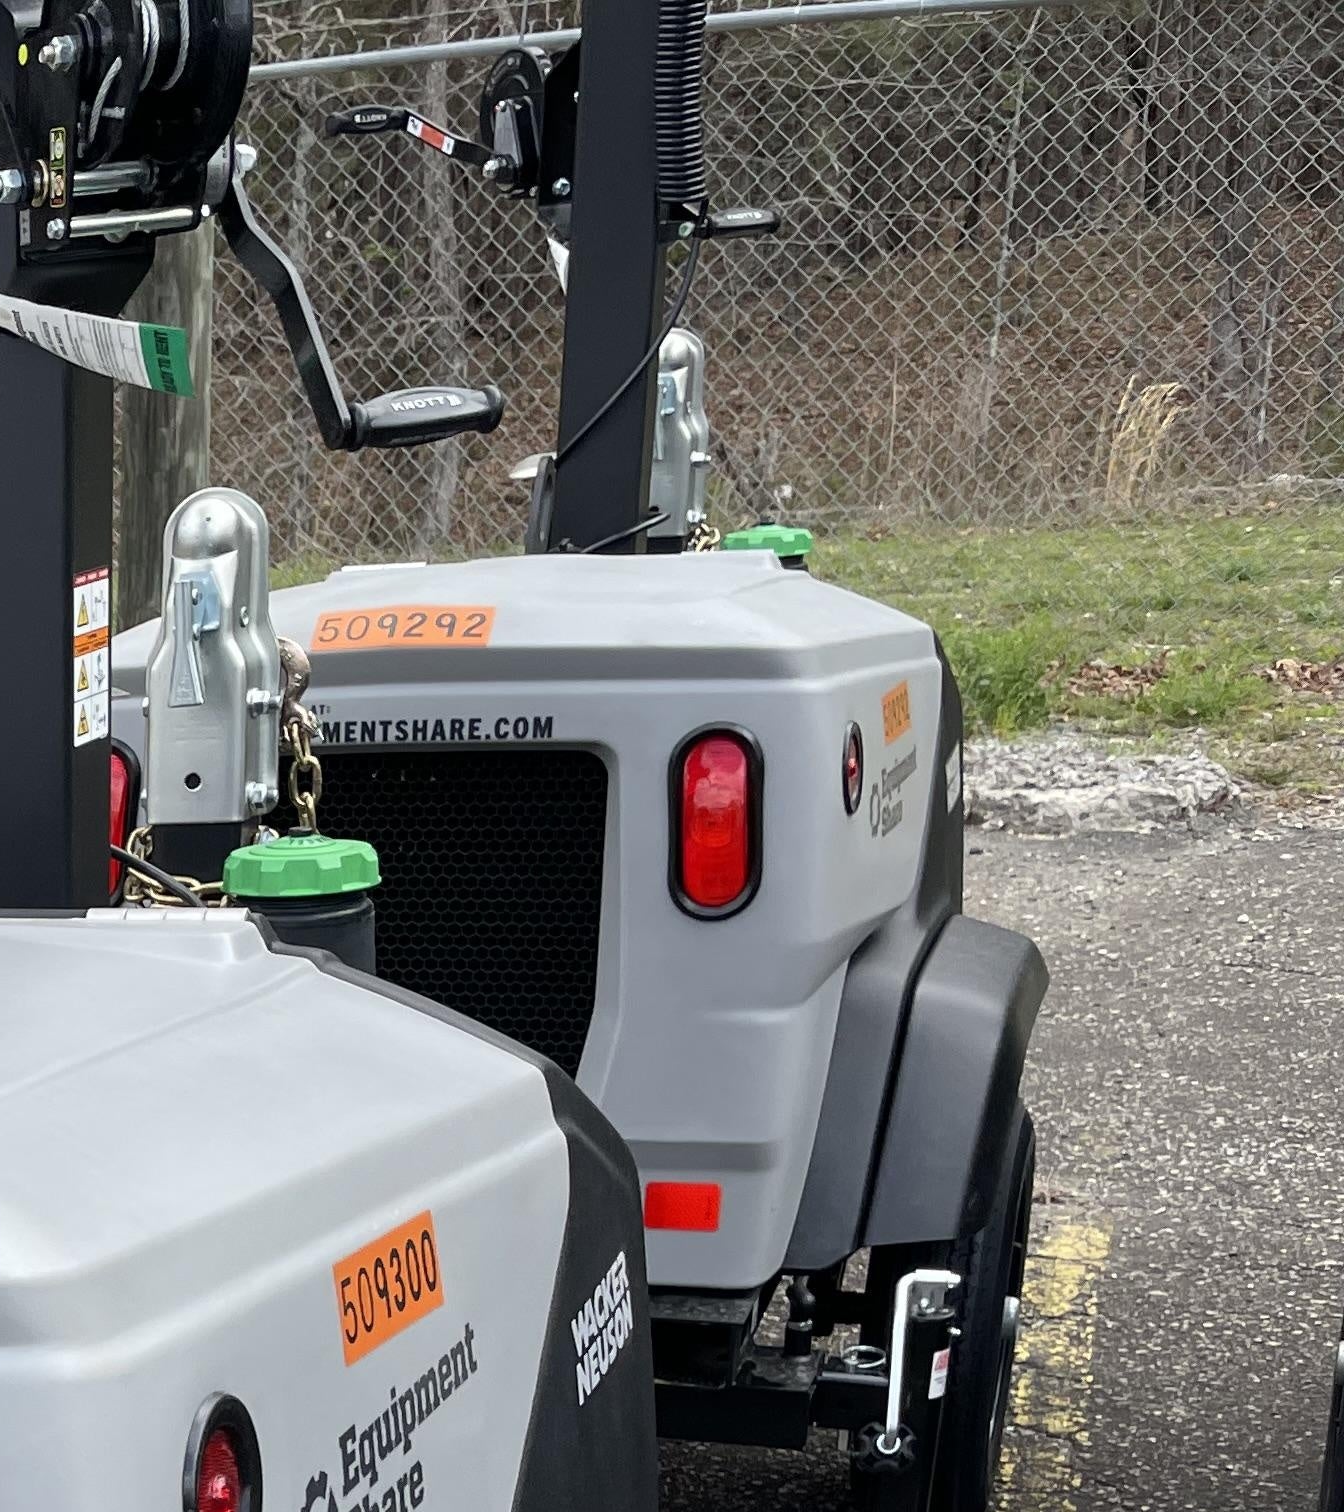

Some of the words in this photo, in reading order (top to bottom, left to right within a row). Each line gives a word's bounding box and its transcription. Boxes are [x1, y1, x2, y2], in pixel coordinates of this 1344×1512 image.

[391, 396, 444, 412] KNOTT
[318, 612, 487, 643] 509292
[321, 716, 554, 744] MENTSHARE.COM
[340, 1229, 438, 1345] 509300
[571, 1250, 629, 1357] WACKER
[575, 1290, 633, 1406] NEUSON
[338, 1322, 478, 1496] Equipment
